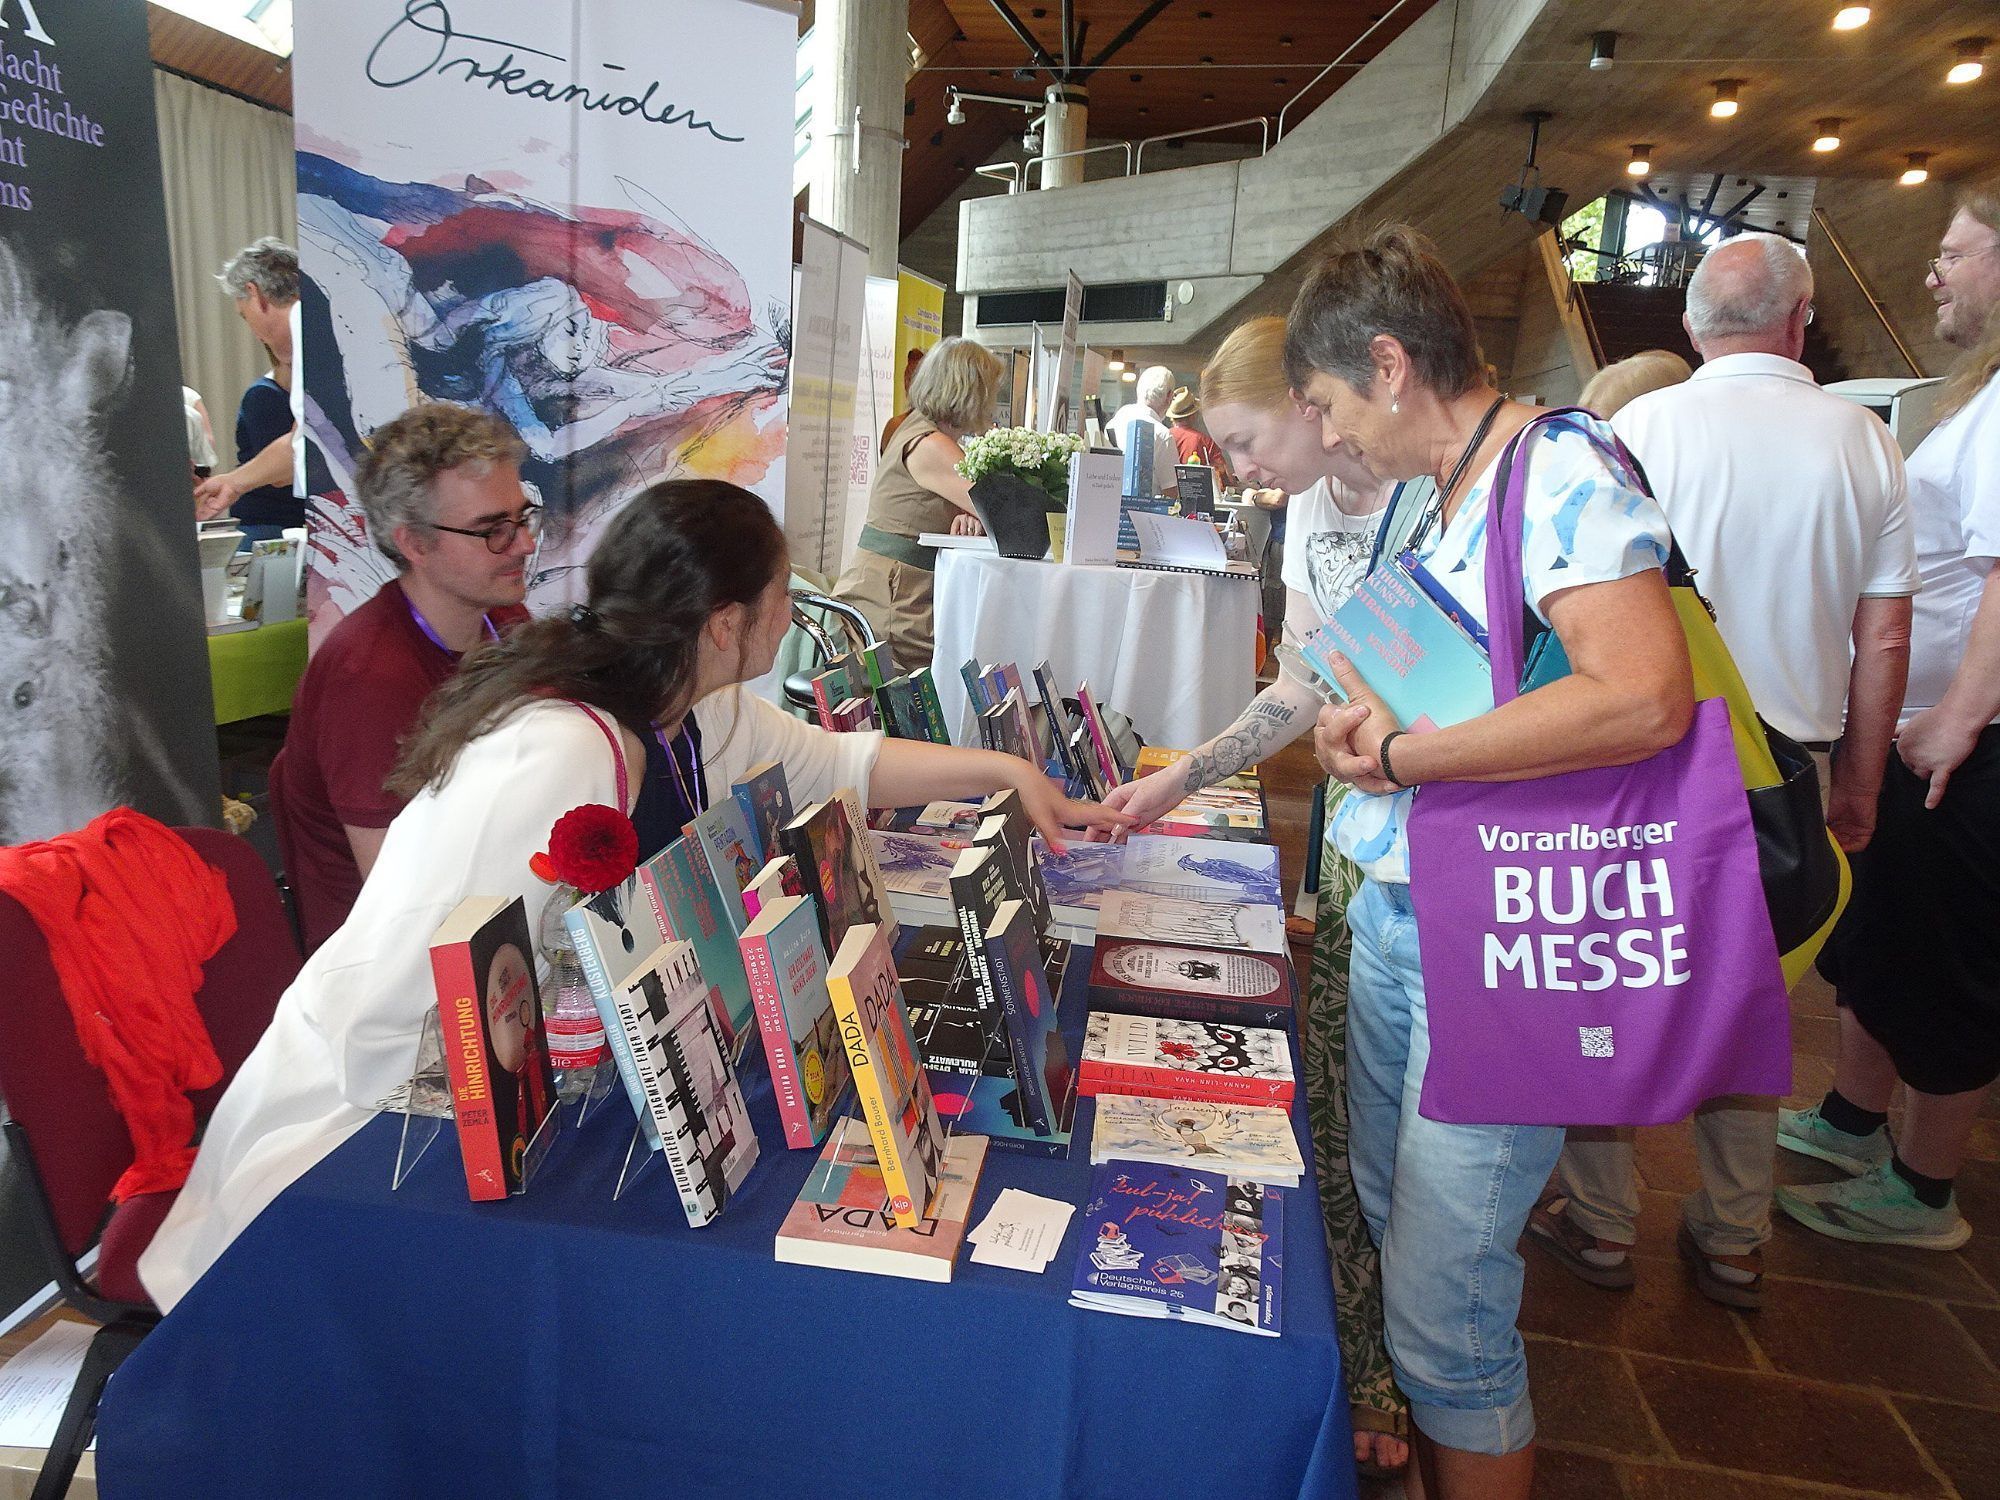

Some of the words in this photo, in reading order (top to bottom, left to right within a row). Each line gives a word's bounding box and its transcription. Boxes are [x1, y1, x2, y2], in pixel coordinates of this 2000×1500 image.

[366, 0, 744, 142] Orkaniden
[1366, 574, 1400, 609] KUNST
[1374, 564, 1418, 609] THOMAS
[1327, 617, 1363, 654] ROMAN
[1478, 821, 1678, 852] Vorarlberger
[1494, 858, 1674, 924] BUCH
[958, 905, 981, 979] DYSFUNCTIONAL
[968, 910, 983, 949] WOMAN
[577, 928, 609, 999] KLOSTERBERG
[1483, 924, 1691, 992] MESSE
[977, 954, 995, 1003] KULEWATZ
[995, 957, 1016, 1015] SONNENSTADT
[864, 965, 898, 1033] DADA
[975, 985, 988, 1010] JULIA
[618, 1003, 639, 1031] STADT
[455, 997, 486, 1100] HINRICHTUNG
[634, 1033, 649, 1069] EINER
[846, 1011, 869, 1067] DADA
[1128, 1022, 1148, 1055] WILD
[775, 1048, 786, 1069] BORA
[929, 1055, 978, 1069] KULEWATZ
[1104, 1066, 1156, 1083] WILD
[458, 1086, 469, 1101] DIE
[645, 1070, 664, 1120] FRAGMENTE
[1174, 1075, 1196, 1084] HAVA
[1199, 1077, 1251, 1090] HANNA-LINN
[461, 1109, 488, 1121] PETER
[462, 1117, 489, 1127] ZEMLA
[869, 1096, 882, 1126] Bauser
[662, 1130, 693, 1194] BLUMENLEERE
[876, 1129, 896, 1172] Bernhard
[1108, 1178, 1201, 1207] kul-ja!
[1124, 1203, 1269, 1247] publishing
[1100, 1272, 1157, 1287] Deutscher
[1100, 1279, 1167, 1295] Verlagspreis
